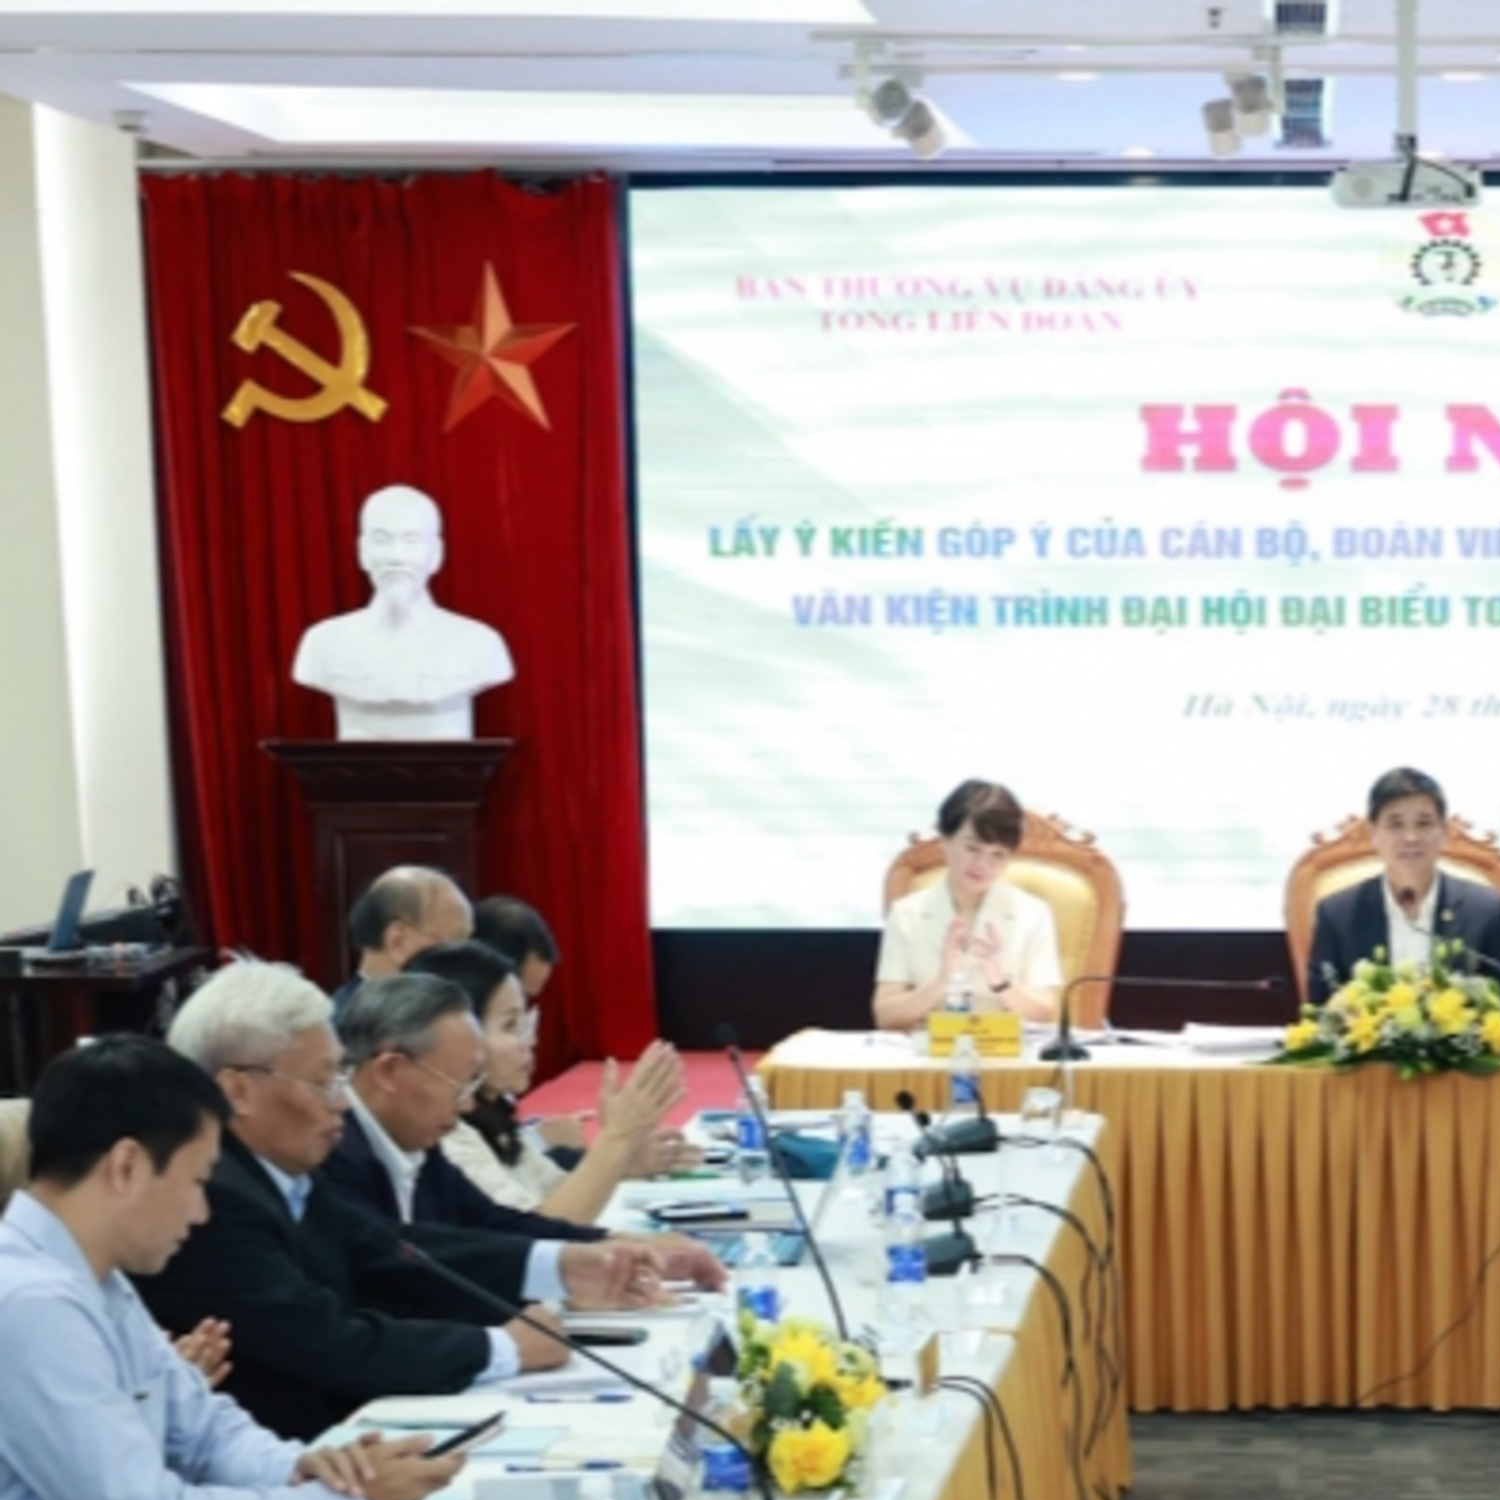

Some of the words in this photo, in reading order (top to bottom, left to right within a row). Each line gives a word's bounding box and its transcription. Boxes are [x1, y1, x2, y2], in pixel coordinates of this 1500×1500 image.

[734, 276, 808, 300] BAN
[1139, 388, 1401, 491] HỘI
[707, 514, 782, 559] LẤY
[793, 519, 818, 559] Ý
[829, 516, 925, 559] KIẾN
[936, 519, 1017, 559] GÓP
[1029, 520, 1052, 559] Ý
[1066, 516, 1146, 559] CỦA
[1255, 520, 1321, 567] BỘ,
[793, 589, 873, 628] VĂN
[885, 588, 979, 635] KIỆN
[991, 590, 1110, 629] TRÌNH
[1120, 595, 1189, 635] ĐẠI
[1200, 589, 1268, 635] HỘI
[1279, 595, 1347, 635] ĐẠI
[1181, 692, 1235, 719] Hà
[1420, 693, 1462, 719] 28
